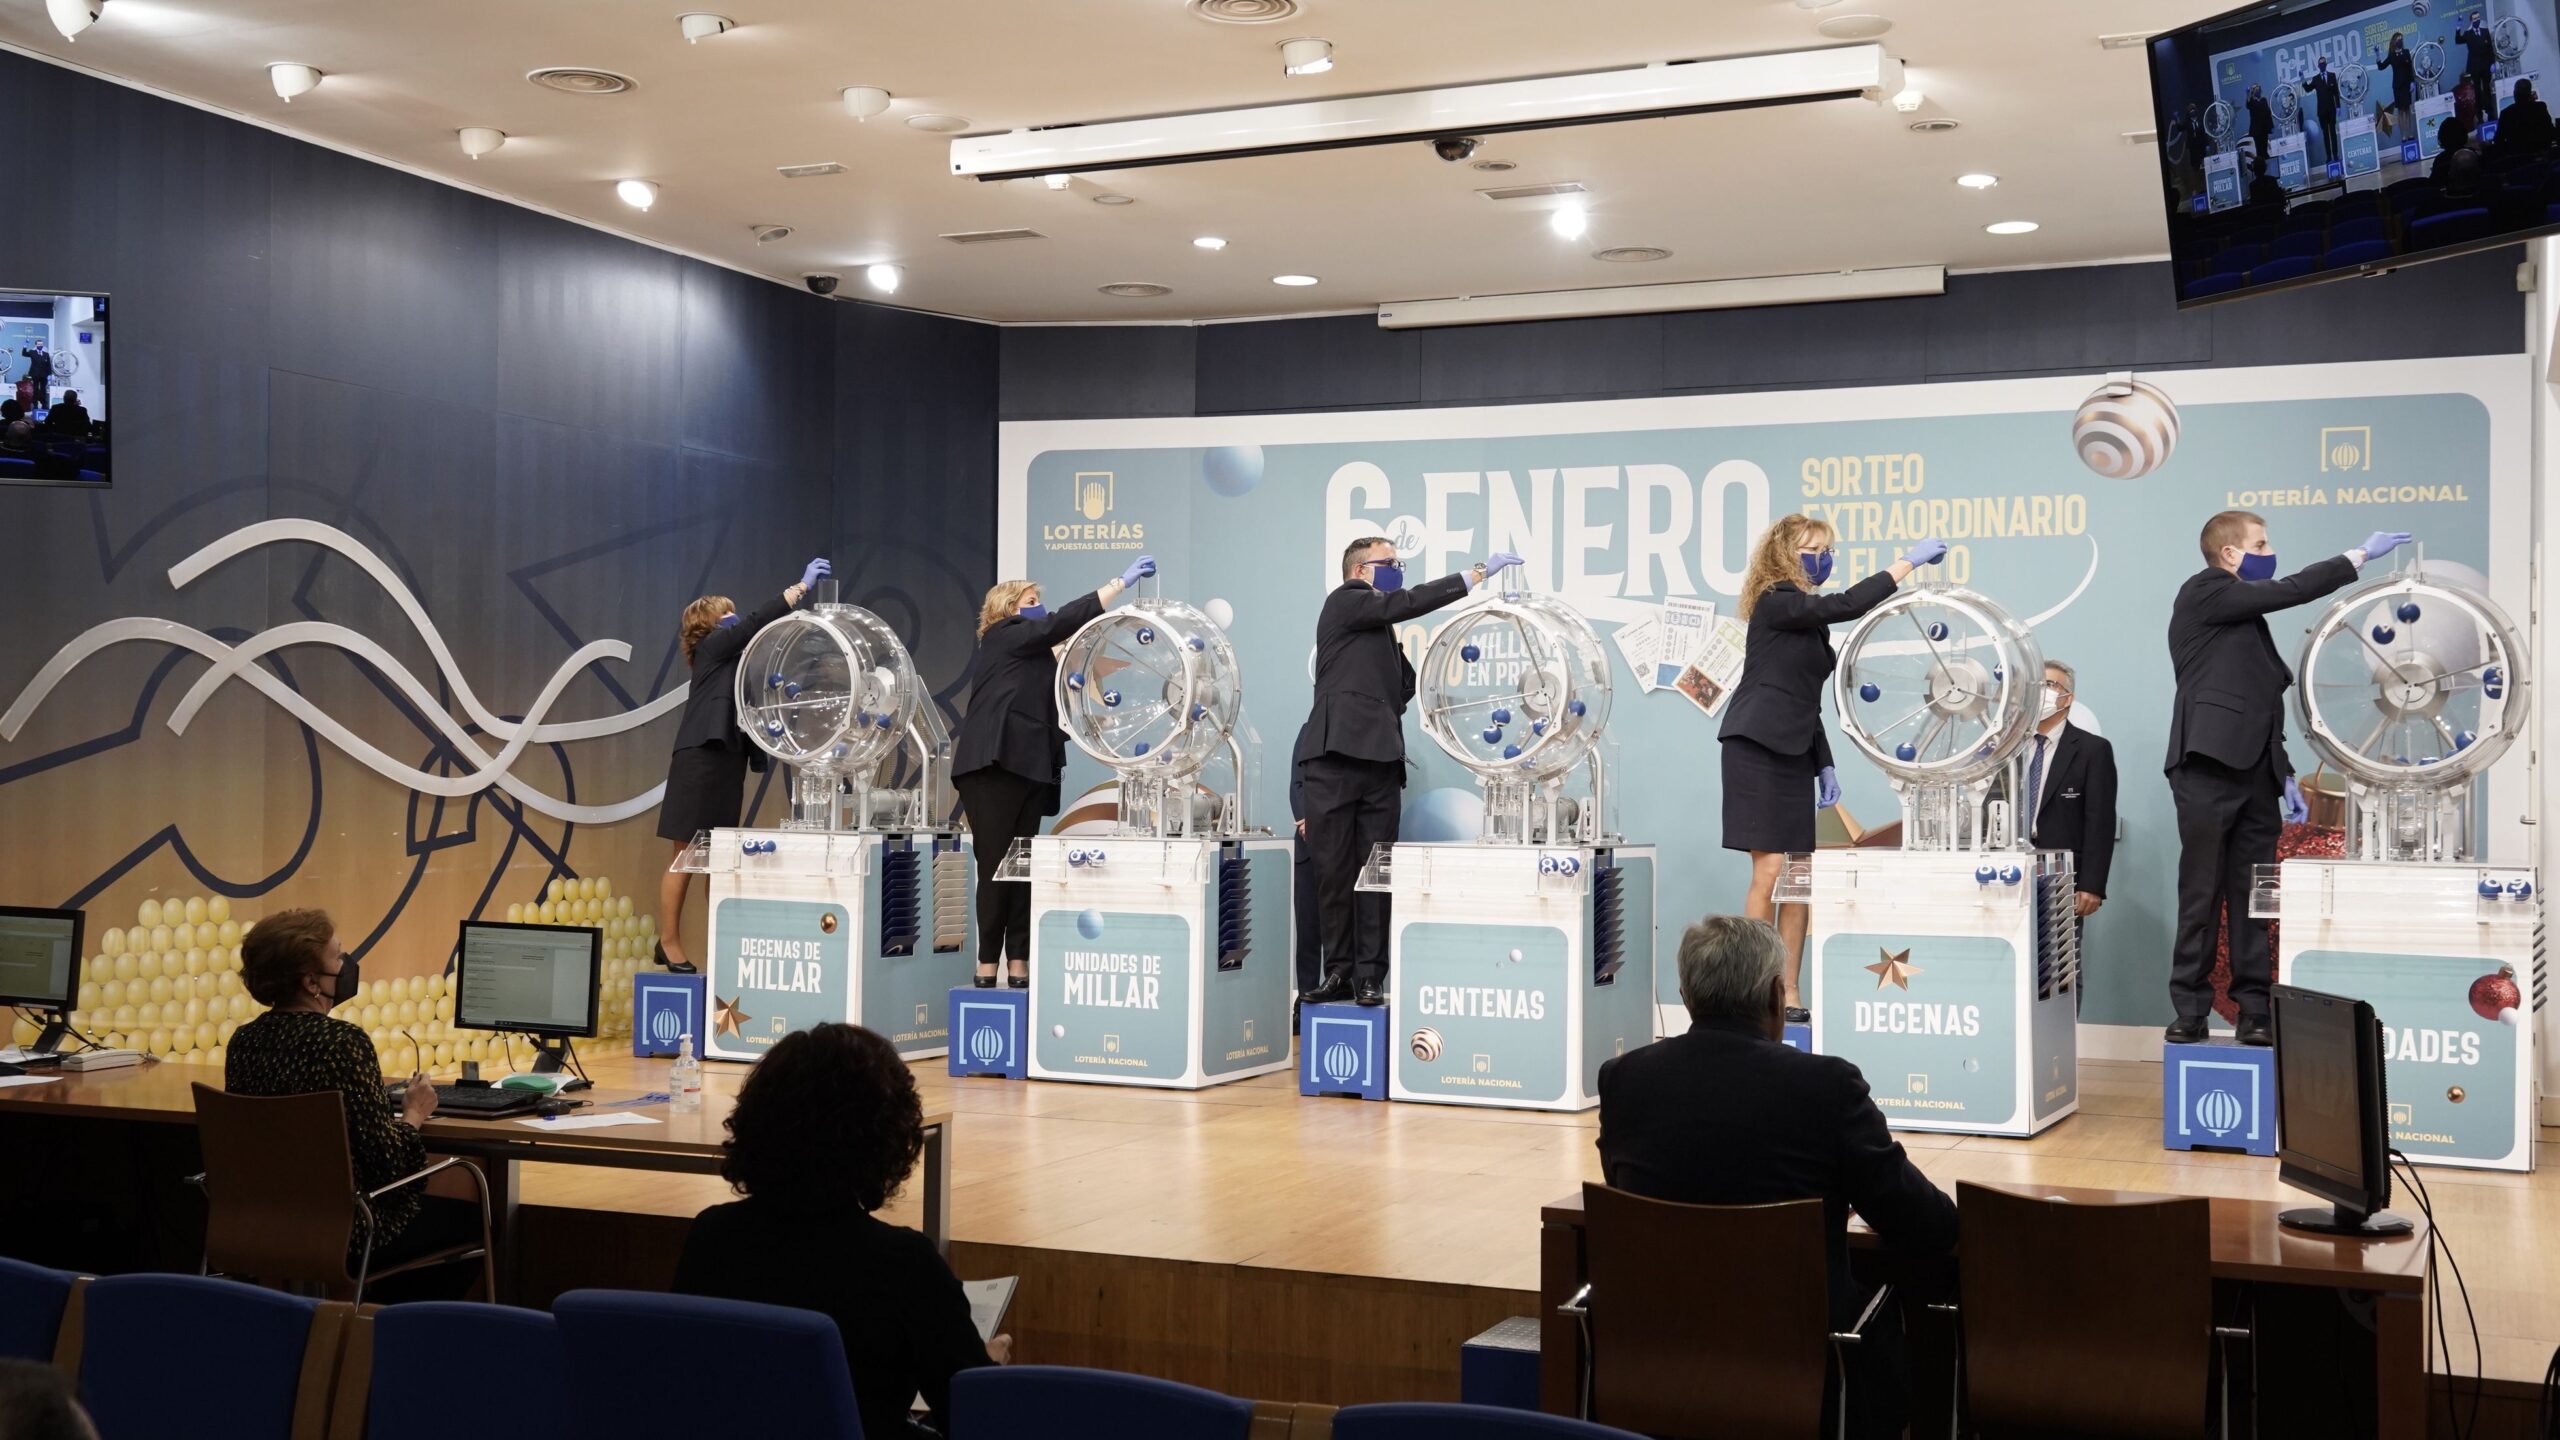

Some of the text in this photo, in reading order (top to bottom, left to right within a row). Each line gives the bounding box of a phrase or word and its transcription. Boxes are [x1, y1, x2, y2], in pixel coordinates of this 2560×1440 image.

[1802, 453, 1924, 497] SORTEO
[2227, 485, 2469, 507] LOTERÍA NACIONAL
[1044, 520, 1144, 540] LOTERÍAS
[1325, 459, 1770, 598] 6 de ENERO
[1044, 543, 1051, 551] Y
[1051, 543, 1092, 551] APUESTAS
[1111, 542, 1144, 551] ESTADO
[1467, 660, 1490, 687] EN
[741, 938, 821, 960] DECENAS DE
[1064, 951, 1161, 975] UNIDADES DE
[737, 957, 822, 993] MILLAR
[1063, 972, 1159, 1010] MILLAR
[1419, 985, 1545, 1020] CENTENAS
[1855, 1001, 1980, 1037] DECENAS
[746, 1036, 774, 1045] LOTERÍA
[892, 1027, 949, 1043] LOTERÍA NACIONAL
[2382, 1026, 2480, 1065] DADES
[1074, 1055, 1148, 1067] LOTERÍA NACIONAL
[1225, 1045, 1269, 1061] LOTERÍA NACIONAL
[1441, 1075, 1522, 1089] LOTERÍA NACIONAL
[1913, 1100, 1965, 1110] NACIONAL
[2395, 1131, 2455, 1144] NACIONAL
